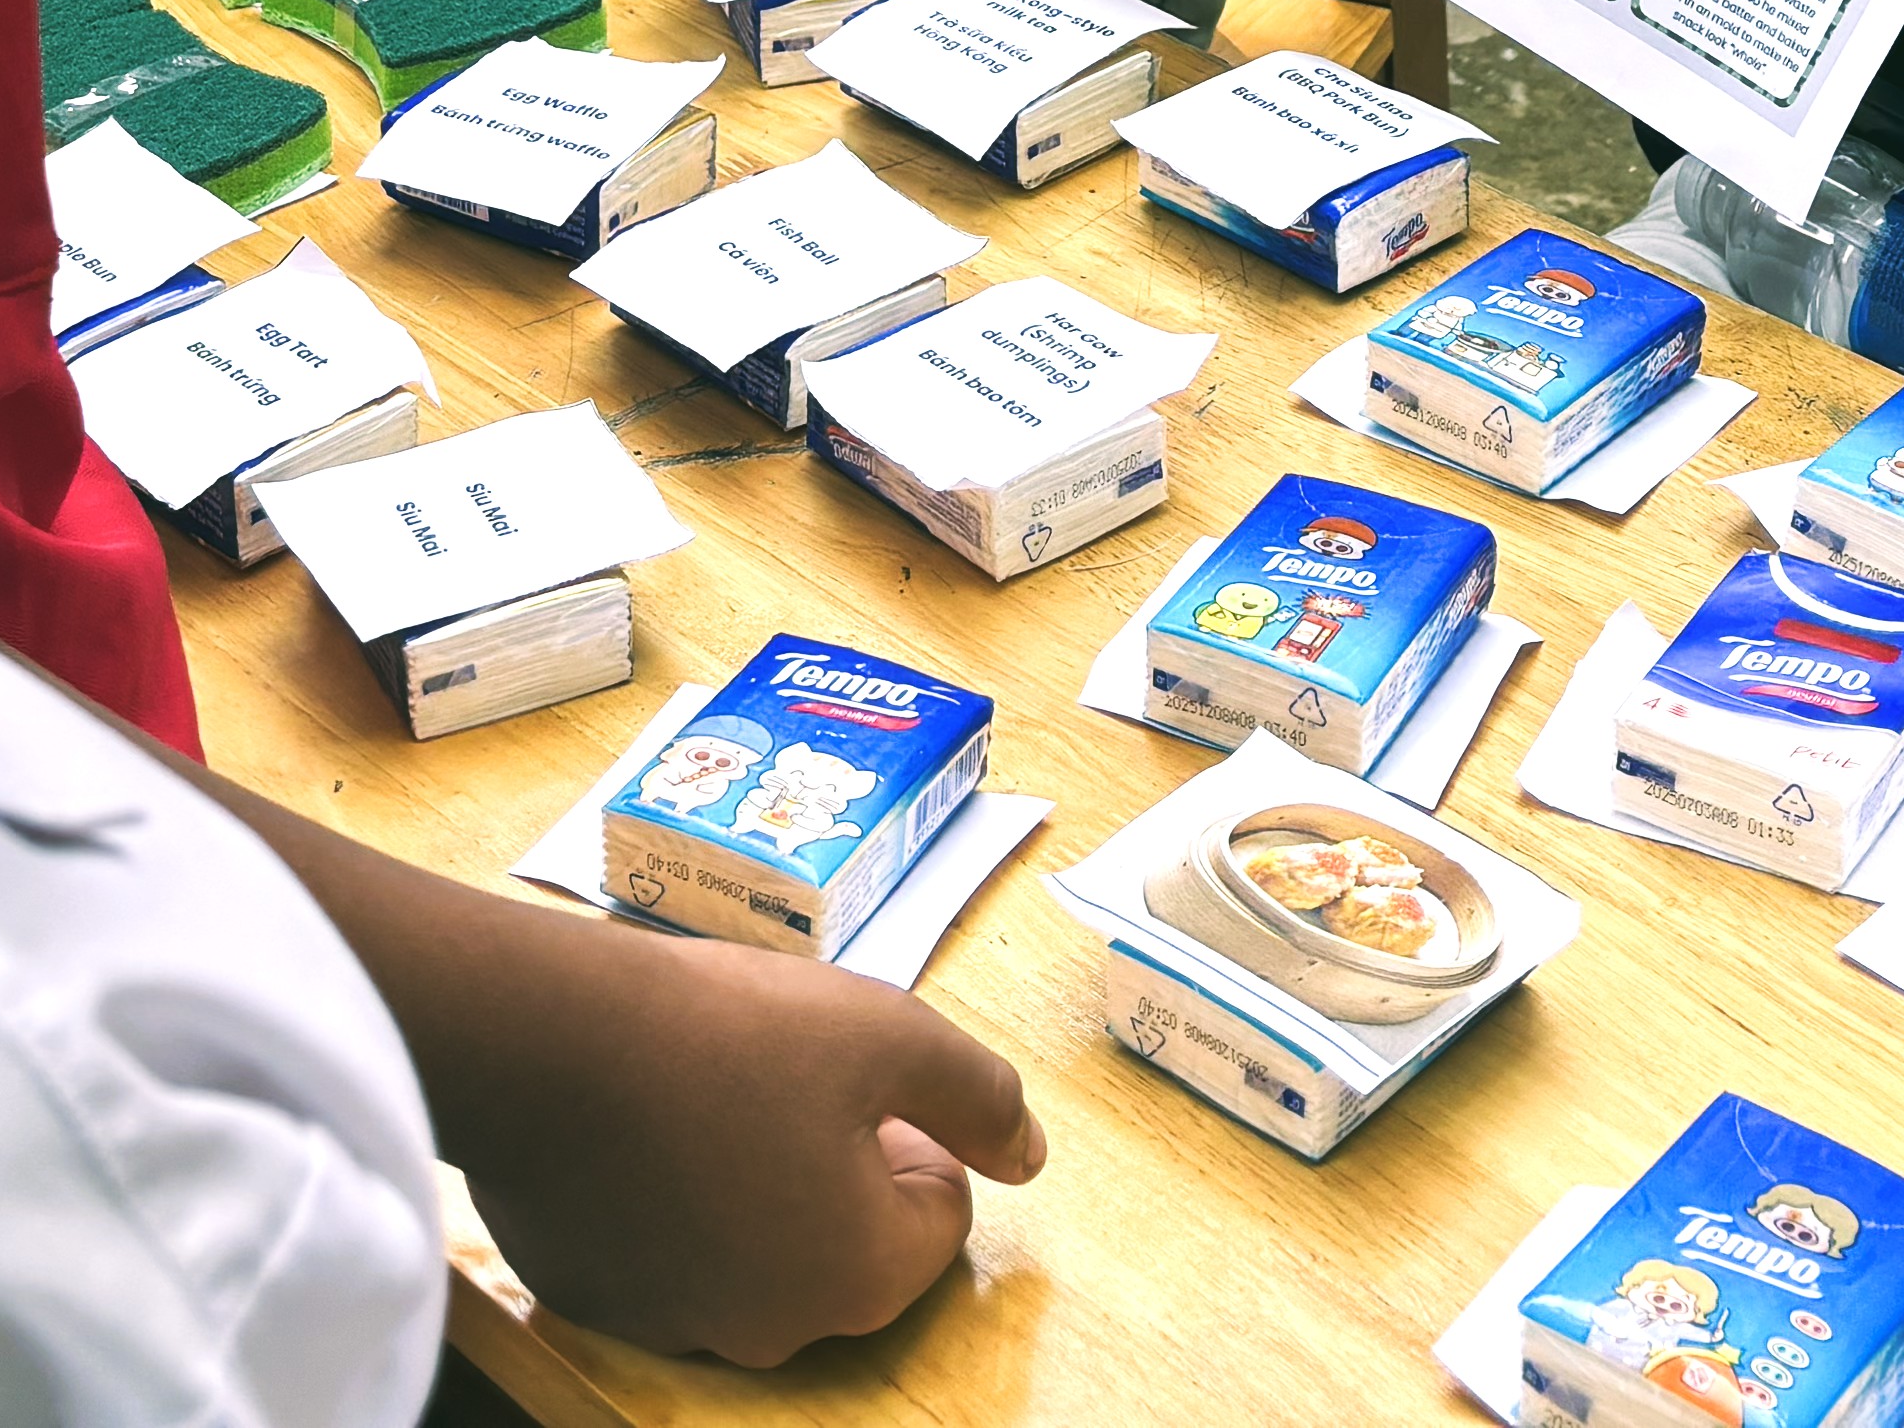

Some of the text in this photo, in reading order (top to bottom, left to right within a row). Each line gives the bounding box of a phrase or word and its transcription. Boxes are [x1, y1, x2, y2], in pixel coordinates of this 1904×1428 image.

[987, 1, 1057, 33] milk tea
[502, 88, 608, 120] Egg Waffle
[1278, 69, 1409, 138] (BBQ Pork Bun)
[1314, 68, 1413, 120] Cha Siu Bao
[431, 105, 483, 124] Bánh
[547, 136, 610, 159] waffle
[1277, 109, 1312, 128] bao
[768, 218, 839, 265] Fish Ball
[1381, 212, 1424, 257] Tempo
[82, 259, 117, 282] Bun
[719, 242, 778, 284] Cá viên
[1479, 285, 1584, 331] Tempo
[256, 323, 328, 368] Egg Tart
[1020, 324, 1096, 371] (Shrimp
[1045, 312, 1124, 359] Har Gow
[187, 342, 281, 406] Bánh trứng
[919, 349, 967, 381] Bánh
[966, 375, 1004, 402] bao
[982, 329, 1090, 395] dumplings)
[396, 501, 448, 557] Siu Mai
[466, 483, 519, 536] Siu Mai
[1261, 546, 1377, 587] Tempo
[771, 653, 918, 705] Tempo
[1719, 636, 1871, 691] Tempo
[829, 706, 879, 724] neutral
[1790, 746, 1861, 770] petit
[1674, 1206, 1819, 1284] Tempo
